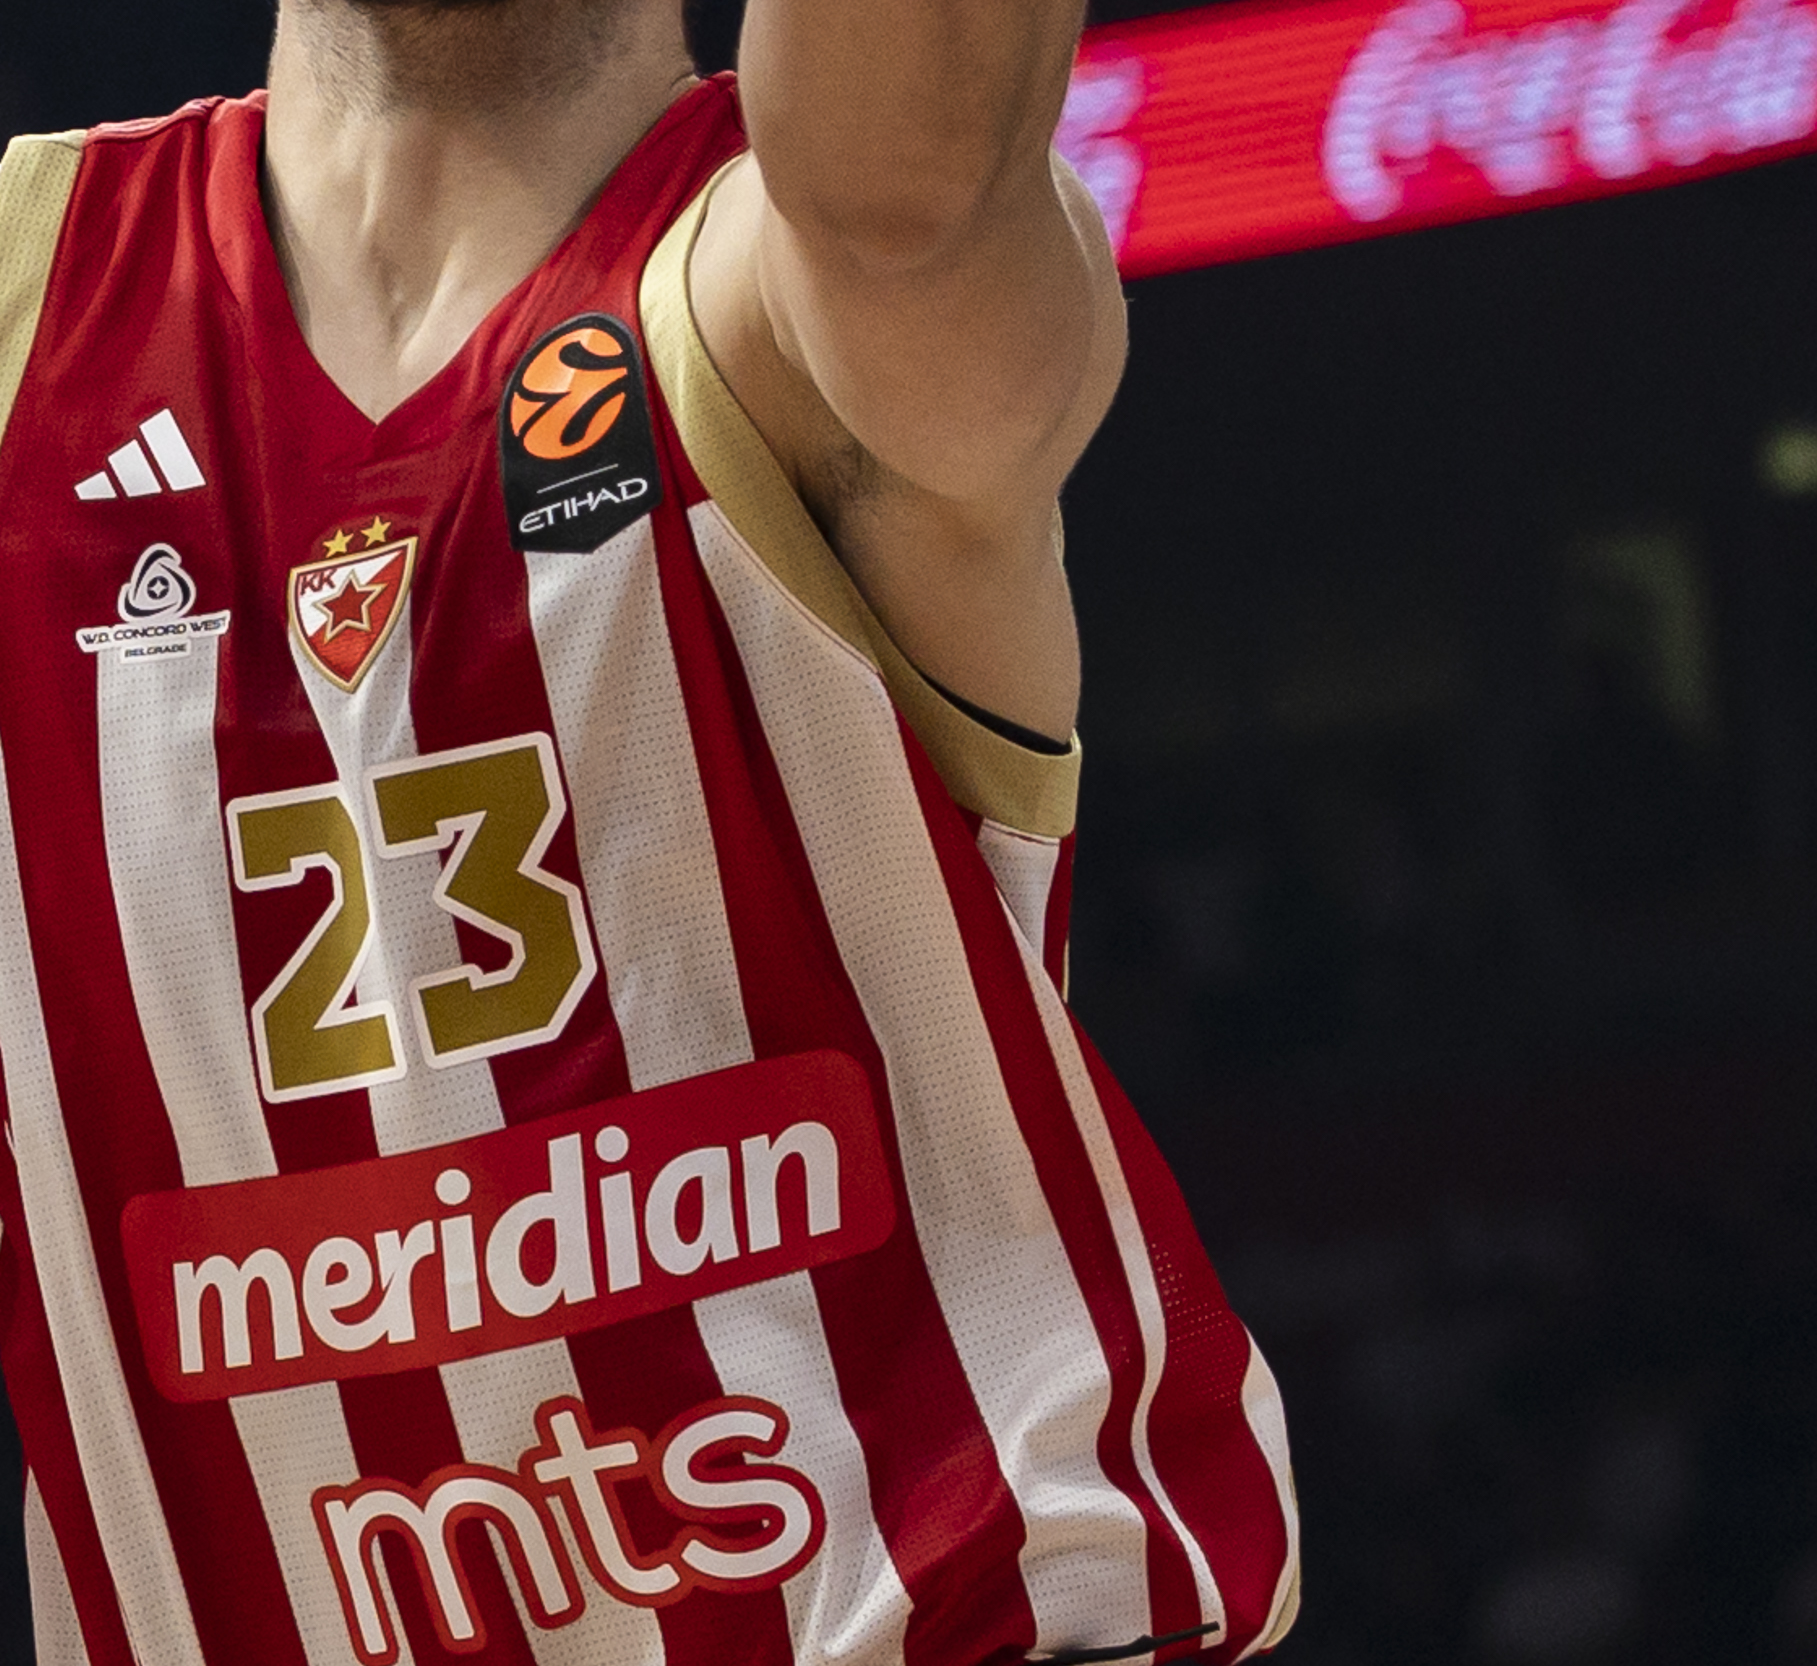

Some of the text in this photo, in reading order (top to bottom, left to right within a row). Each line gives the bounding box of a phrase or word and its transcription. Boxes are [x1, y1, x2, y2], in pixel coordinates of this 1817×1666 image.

[519, 478, 648, 533] ETIHAD
[113, 623, 187, 642] CONCORD
[124, 643, 187, 658] BELGRADE
[225, 731, 598, 1104] 23
[172, 1118, 842, 1376] meridian
[315, 1399, 822, 1665] mts
